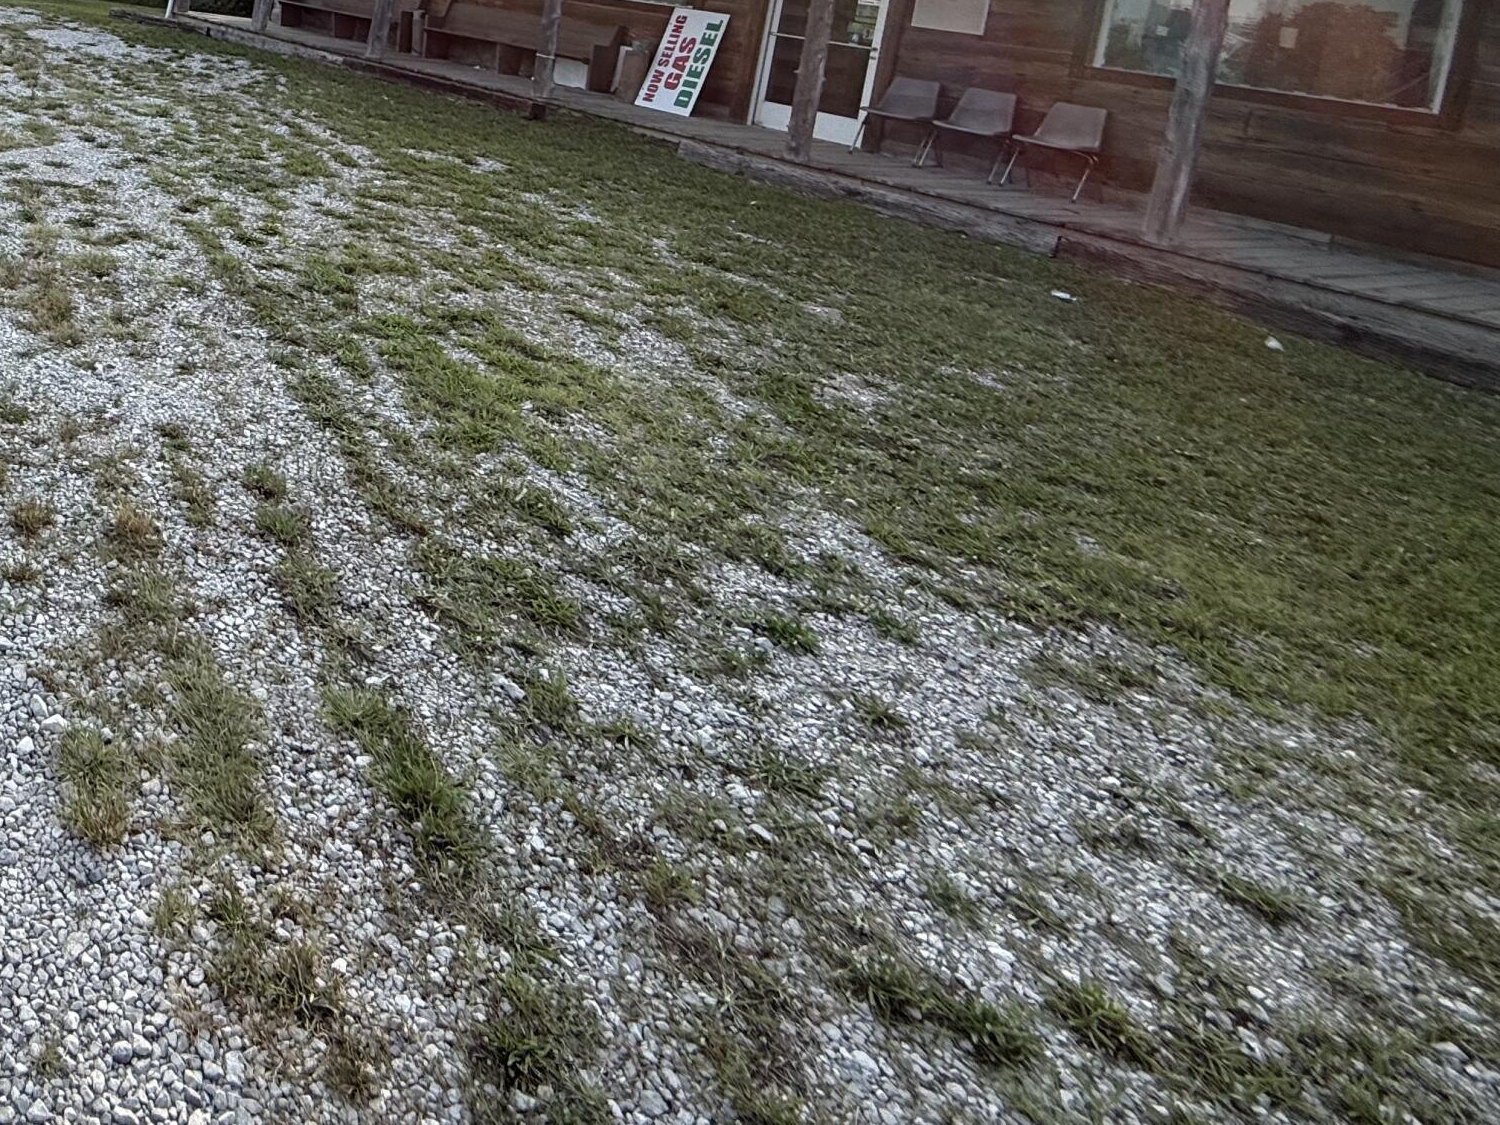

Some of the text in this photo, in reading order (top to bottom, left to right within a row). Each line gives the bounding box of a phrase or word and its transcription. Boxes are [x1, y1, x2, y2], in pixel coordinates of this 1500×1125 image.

[642, 14, 688, 103] NOW SELLING
[663, 36, 697, 91] GAS
[673, 19, 724, 109] DIESEL
